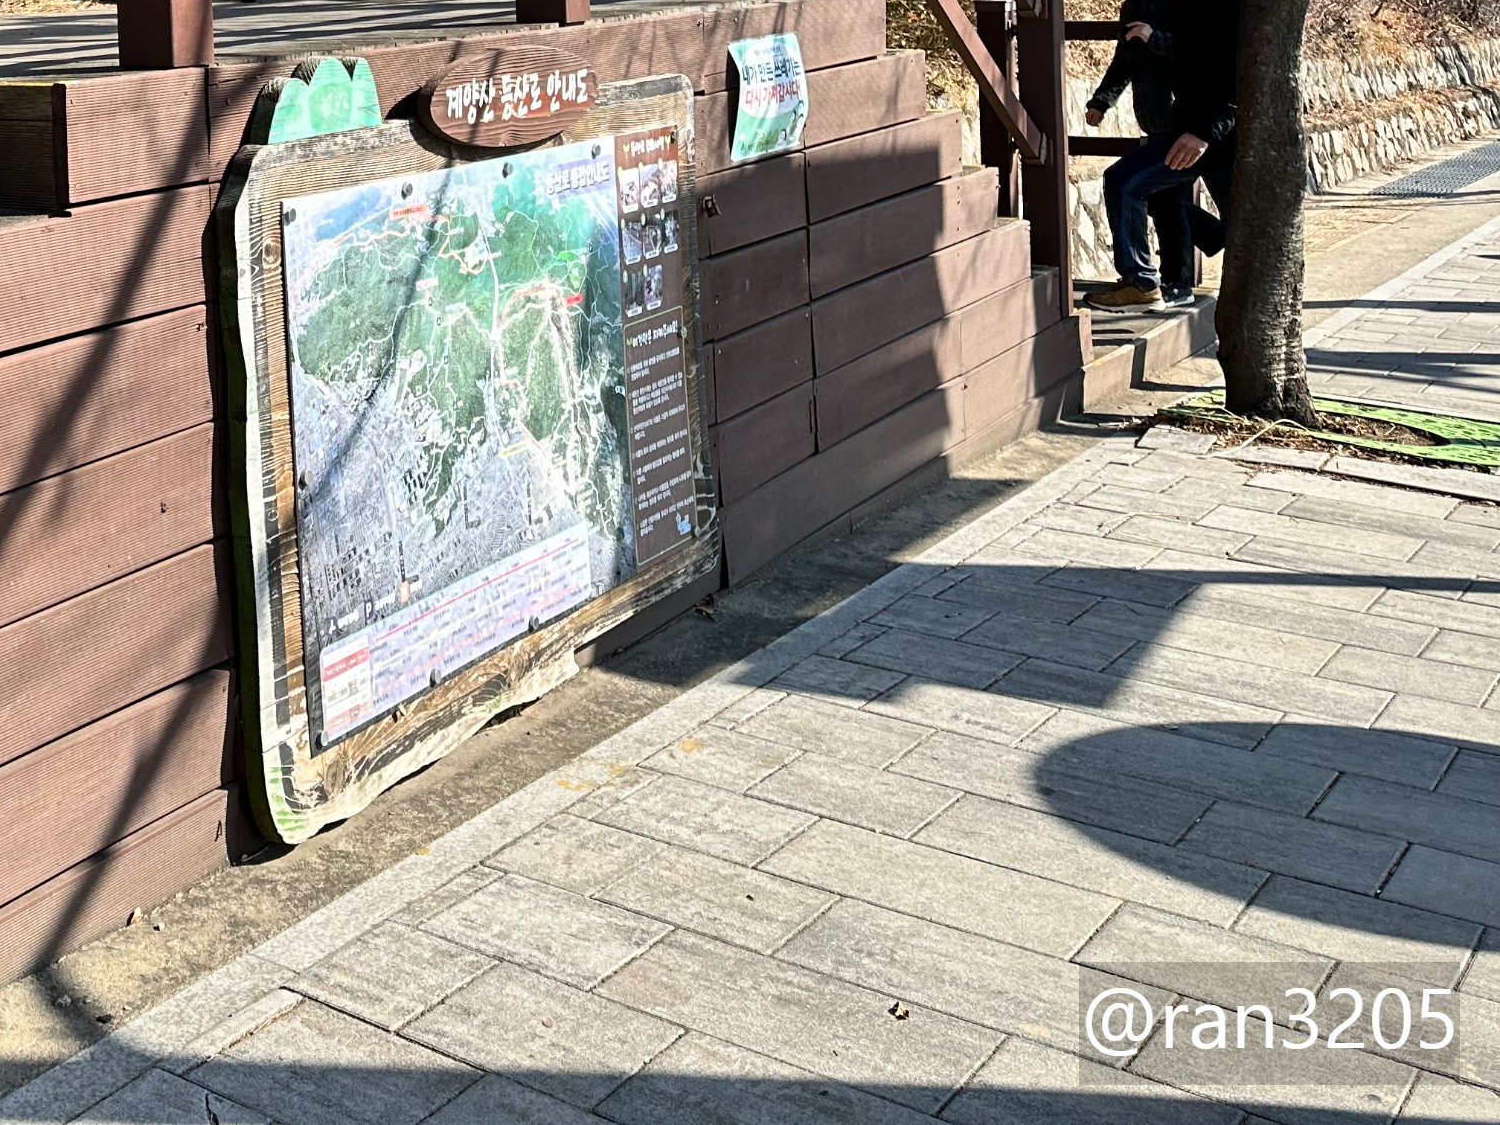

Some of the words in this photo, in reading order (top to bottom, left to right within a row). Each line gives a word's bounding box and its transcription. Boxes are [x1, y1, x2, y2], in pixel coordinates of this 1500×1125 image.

[742, 64, 757, 85] 내가
[759, 62, 773, 82] 만든
[774, 57, 801, 78] 쓰레기는
[446, 78, 496, 124] 계양산
[500, 73, 542, 120] 등산로
[546, 69, 589, 112] 안내도
[745, 86, 762, 109] 다시
[546, 168, 570, 195] 등산로
